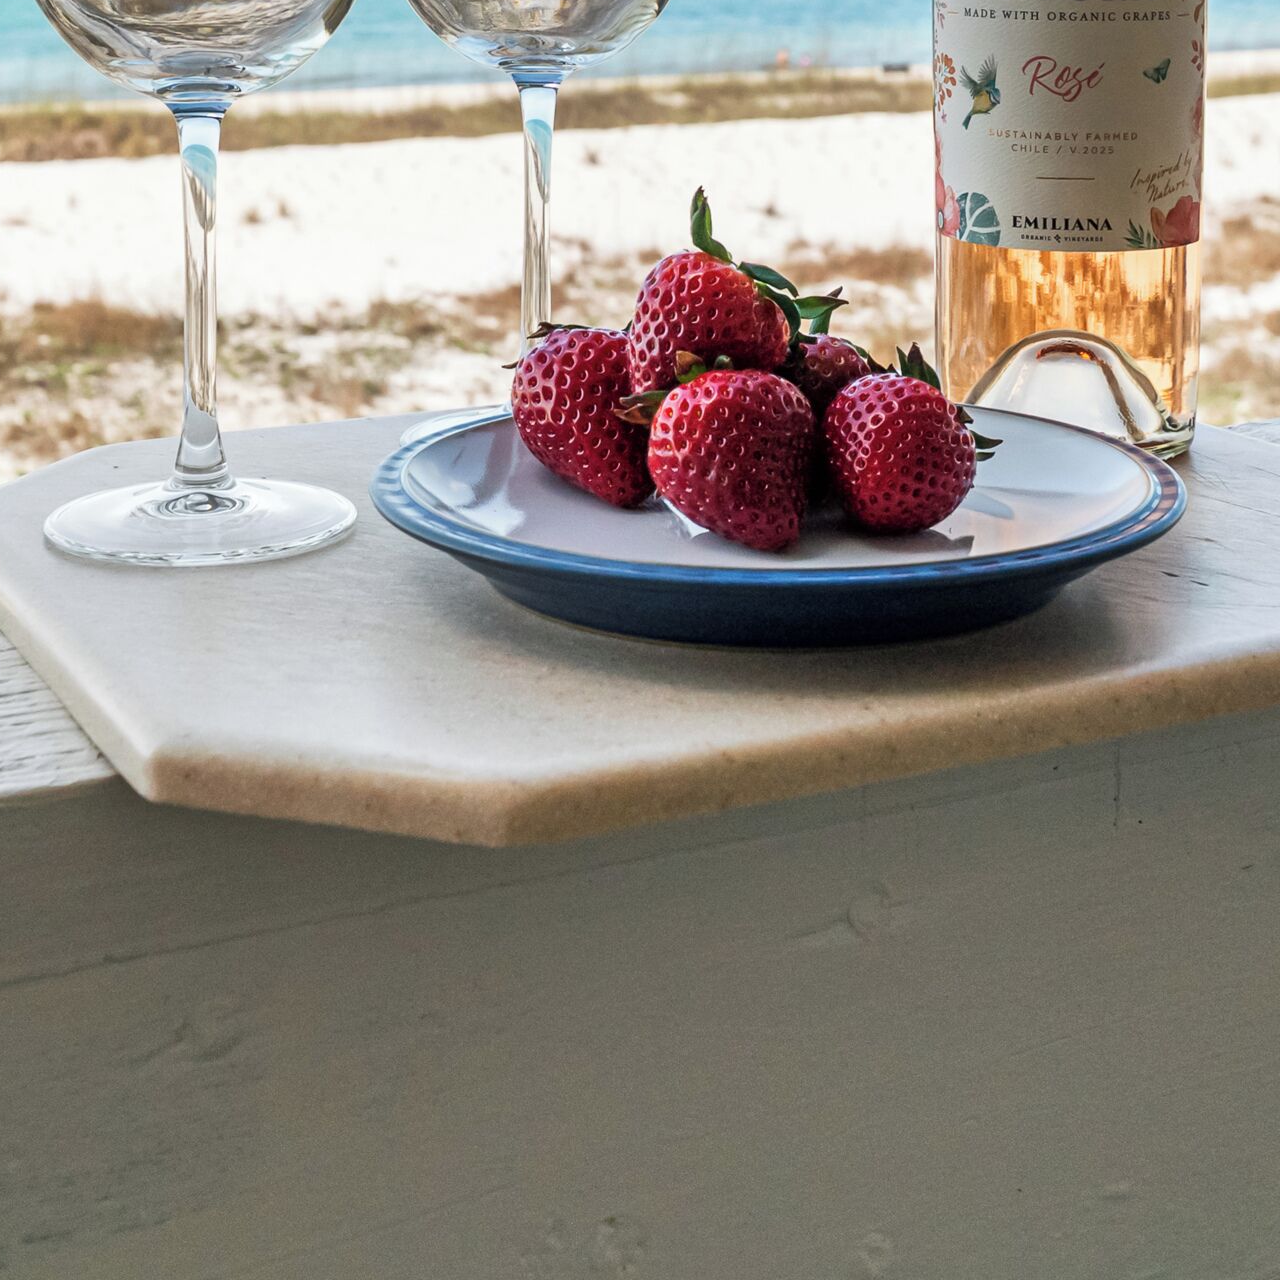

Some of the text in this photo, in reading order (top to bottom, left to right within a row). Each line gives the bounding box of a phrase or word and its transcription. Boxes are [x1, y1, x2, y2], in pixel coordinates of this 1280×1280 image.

[964, 7, 1171, 22] MADE WITH ORGANIC GRAPES
[1022, 55, 1106, 103] Rosé
[988, 128, 1138, 141] SUSTAINABLY FARMED
[1011, 143, 1049, 154] CHILE
[1012, 215, 1113, 231] EMILIANA
